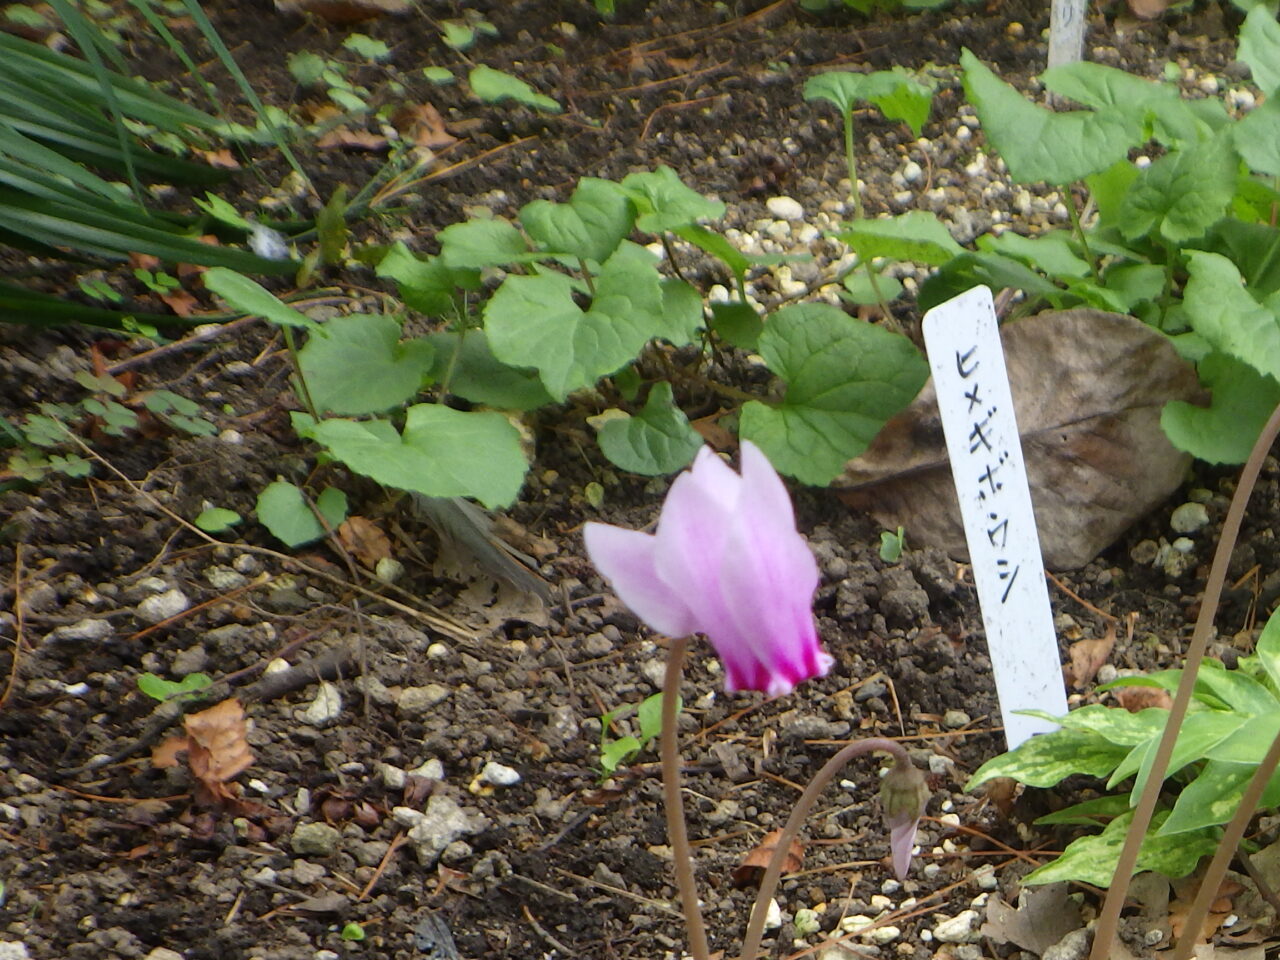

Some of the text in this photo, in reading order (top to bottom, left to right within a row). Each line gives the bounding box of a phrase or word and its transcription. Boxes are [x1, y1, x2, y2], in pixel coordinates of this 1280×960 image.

[955, 344, 1021, 605] ヒメギボウシ
